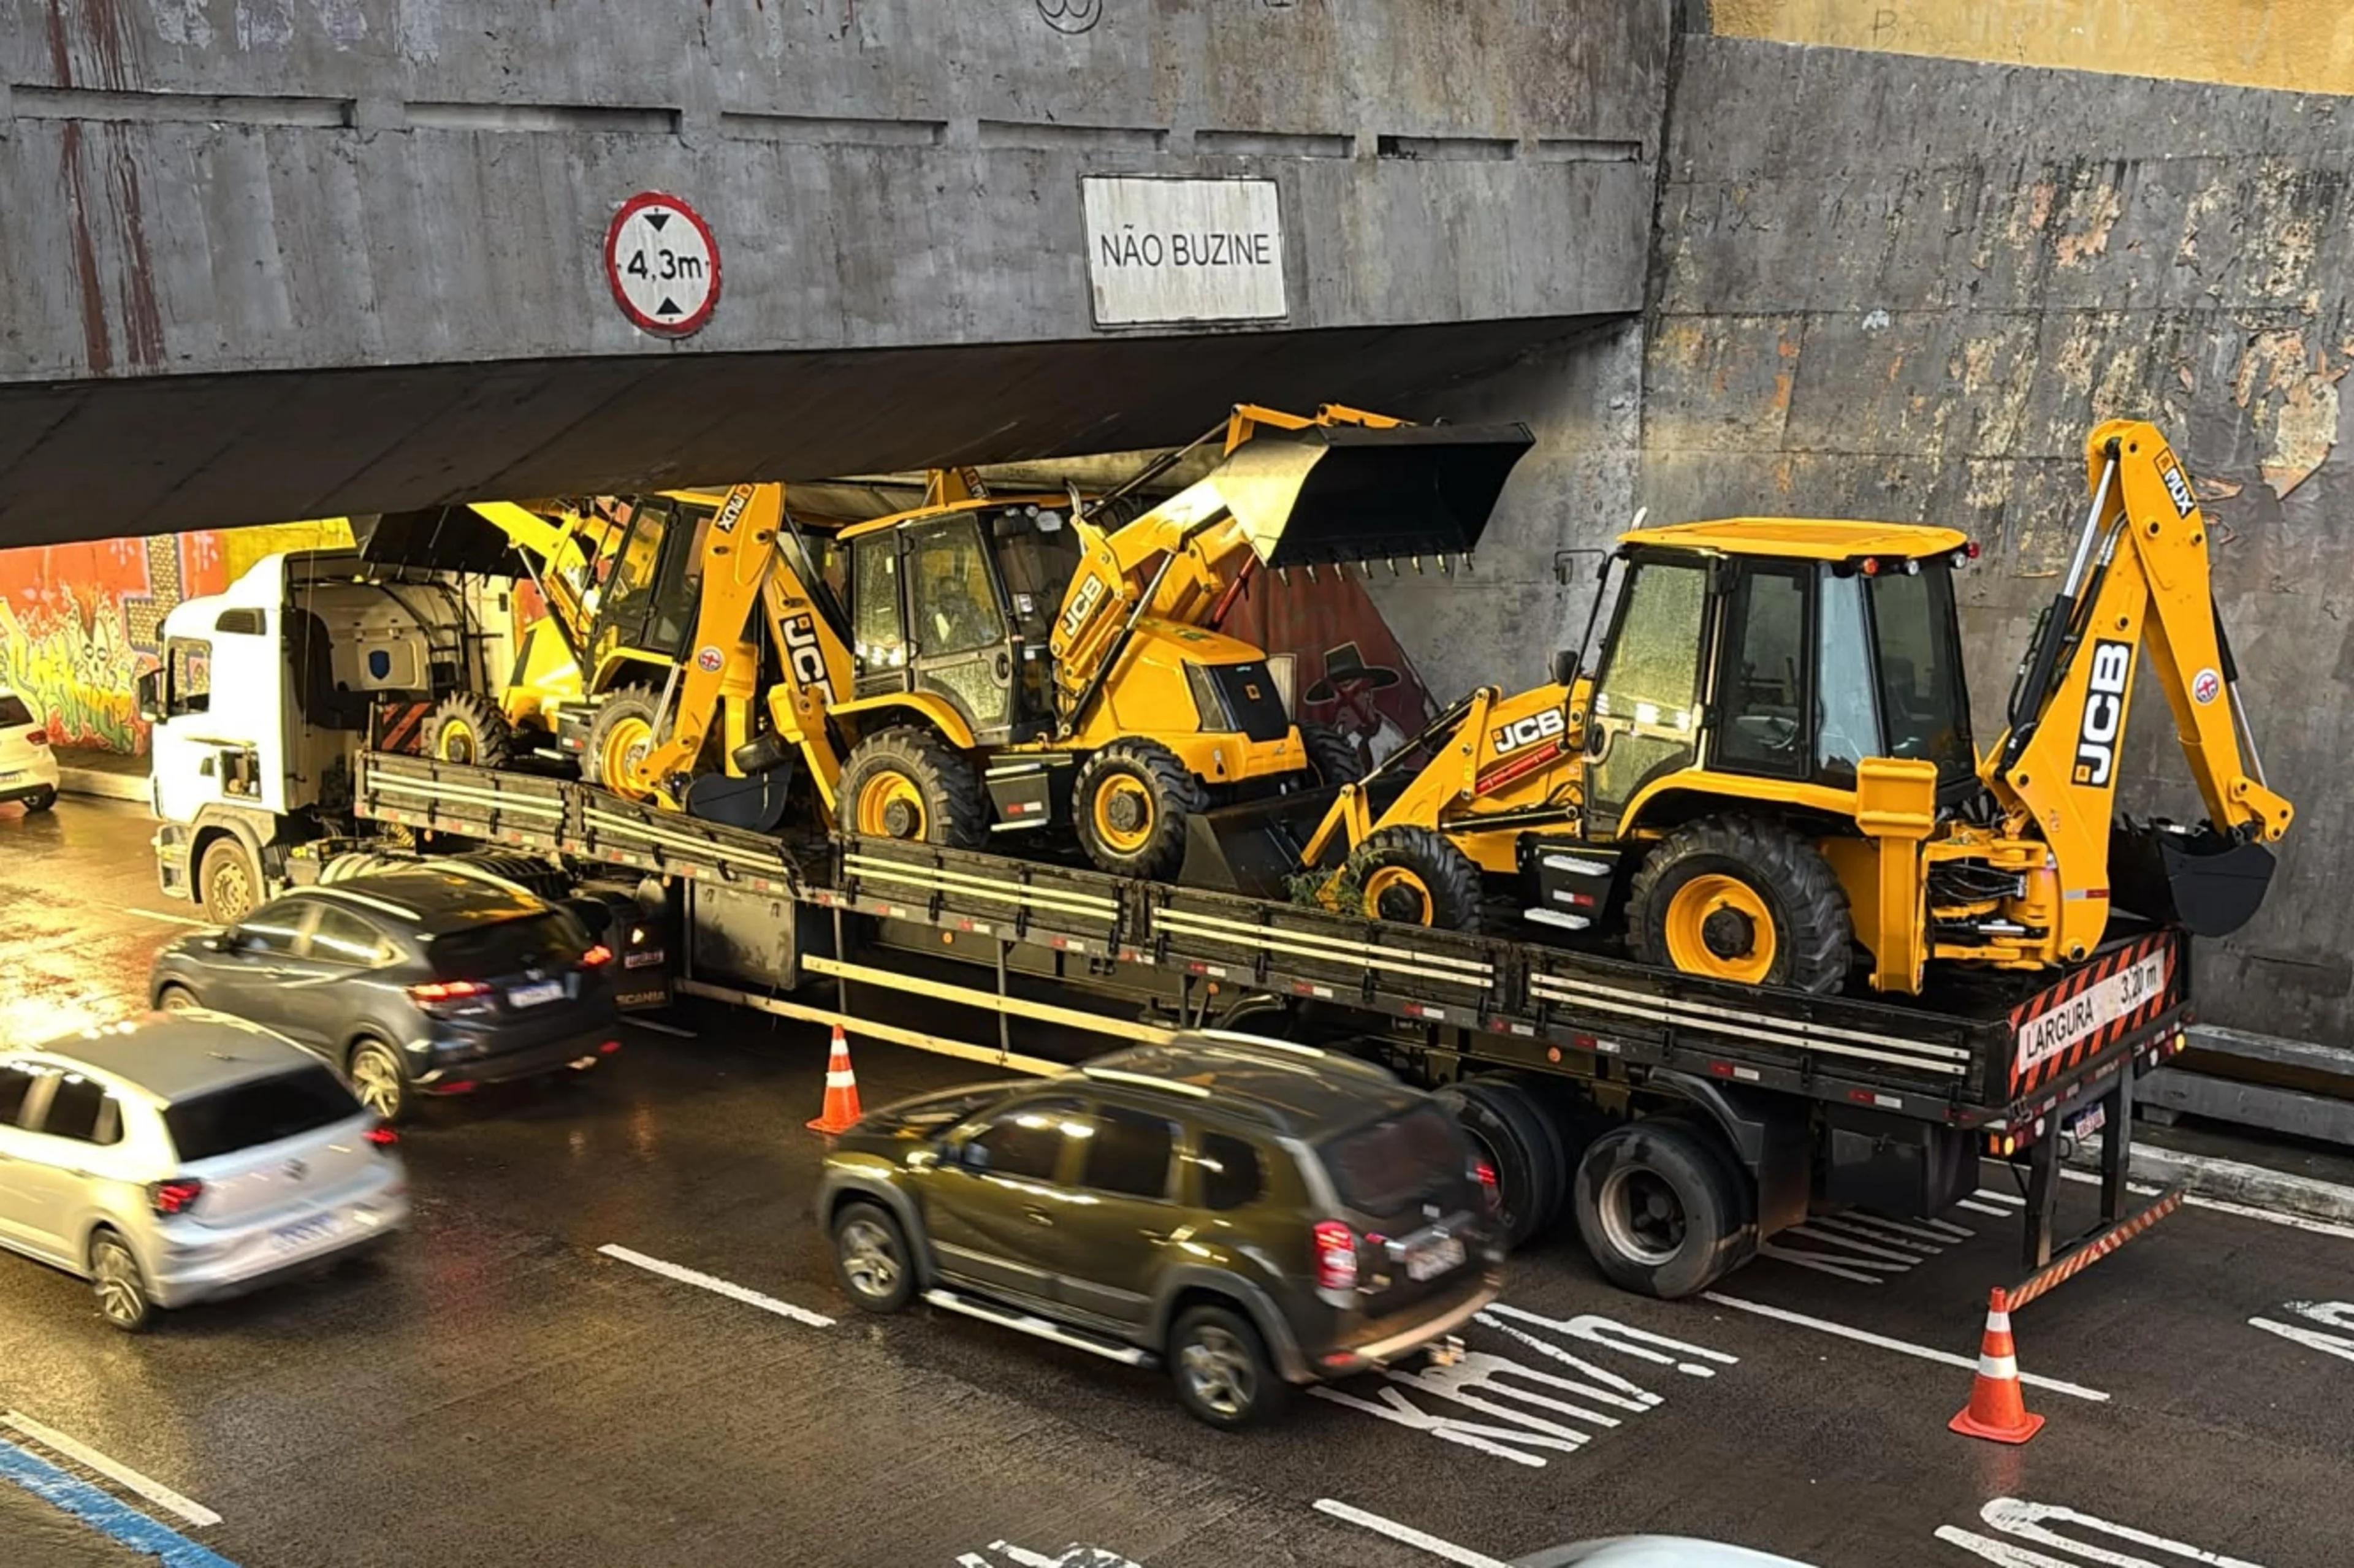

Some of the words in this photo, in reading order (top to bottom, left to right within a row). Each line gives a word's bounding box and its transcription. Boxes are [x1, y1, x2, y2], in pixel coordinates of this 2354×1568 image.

[627, 249, 703, 283] 4,3m
[1101, 223, 1164, 268] NÃO
[1172, 233, 1271, 267] BUZINE
[1064, 574, 1103, 636] JCB
[1494, 708, 1565, 753] JCB
[2077, 643, 2130, 785] JCB
[2026, 997, 2094, 1059] LARGURA
[2146, 964, 2157, 988] m
